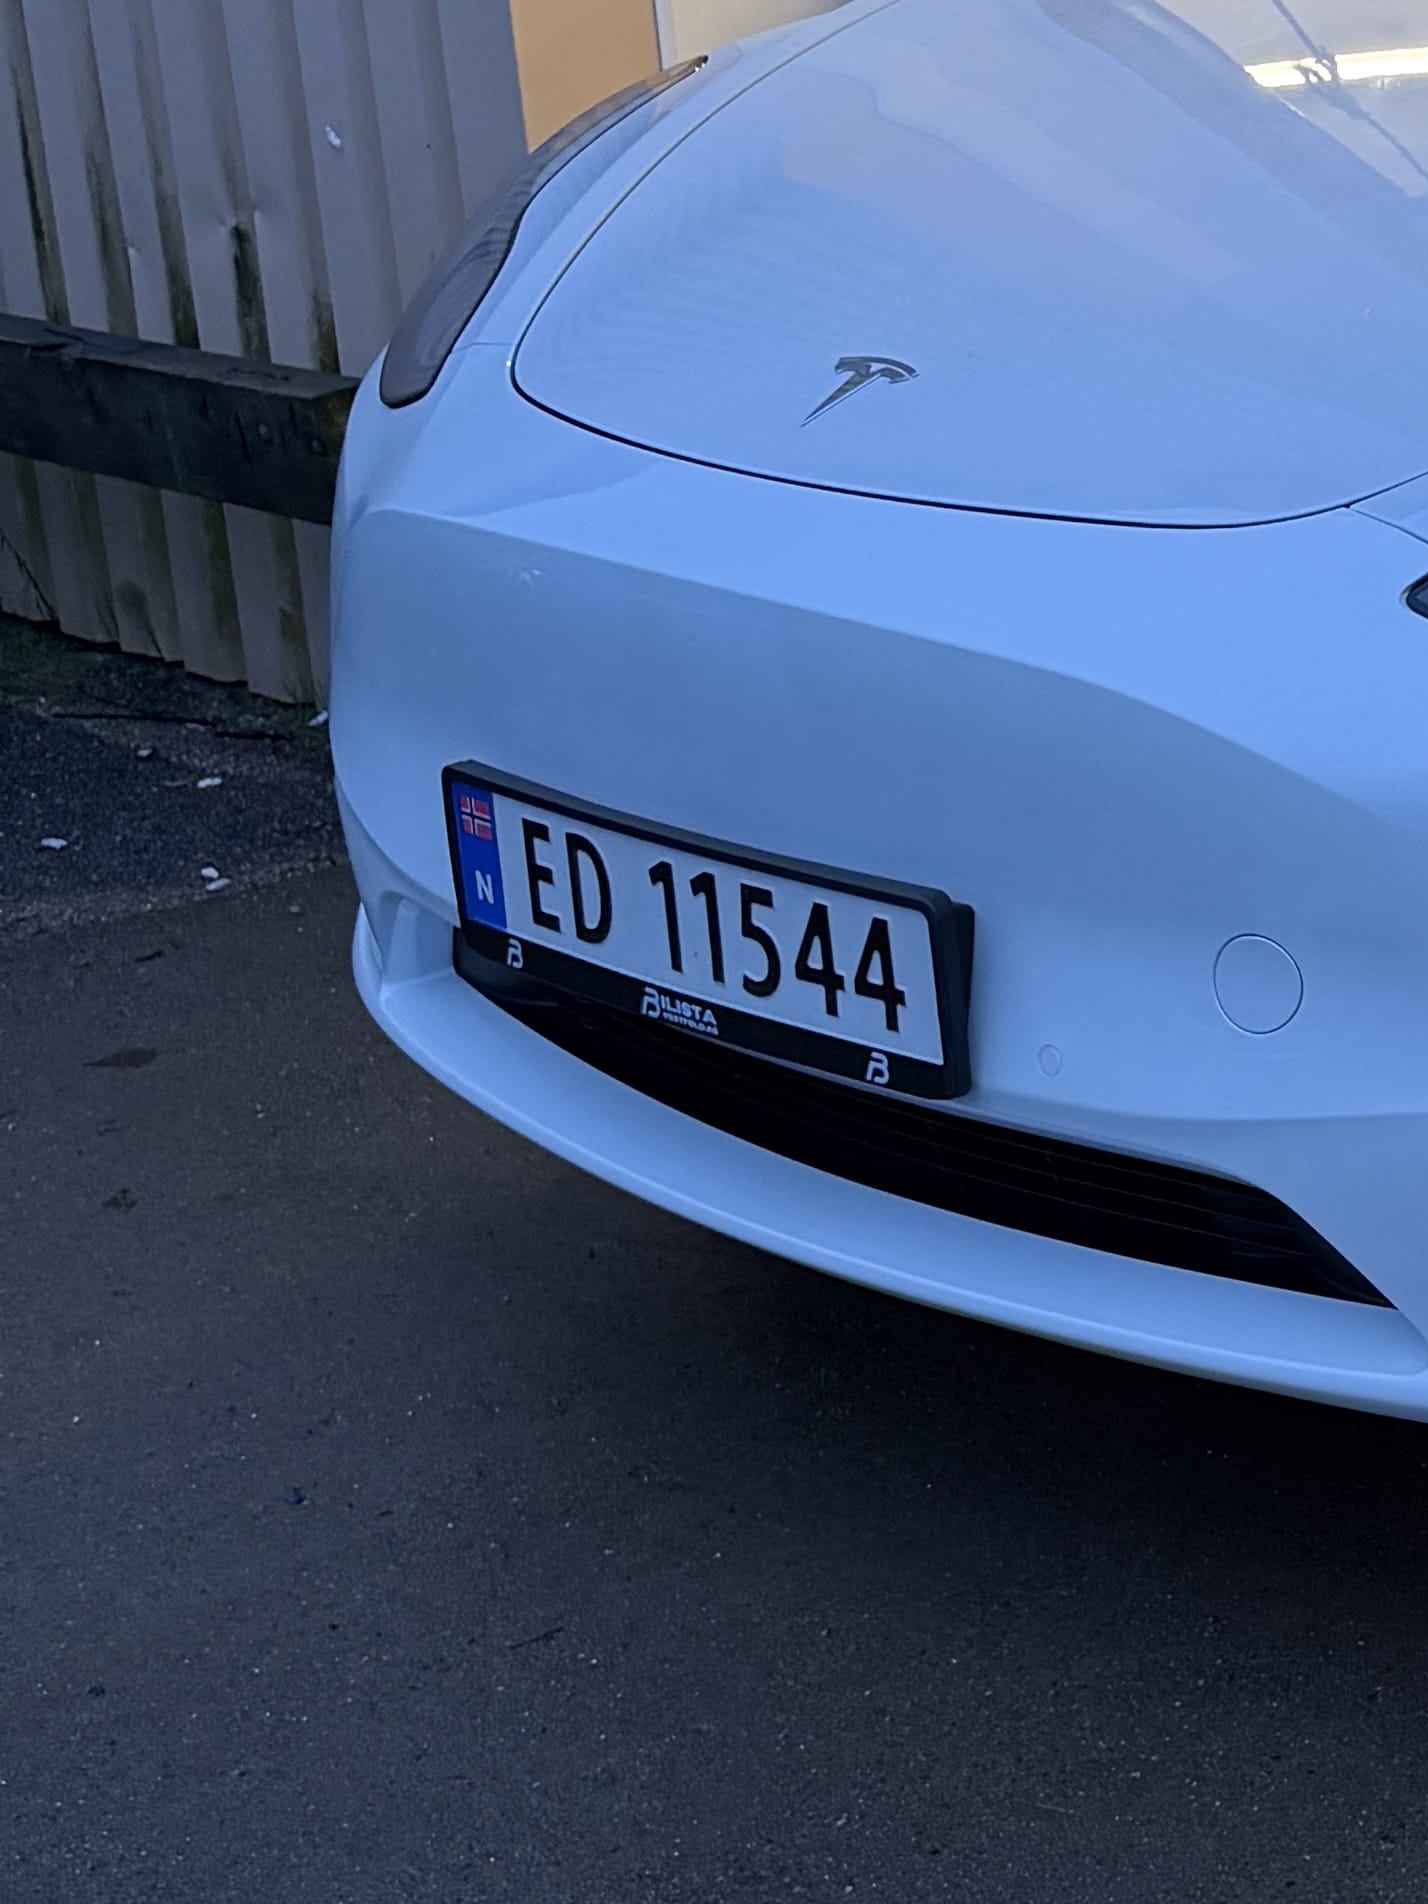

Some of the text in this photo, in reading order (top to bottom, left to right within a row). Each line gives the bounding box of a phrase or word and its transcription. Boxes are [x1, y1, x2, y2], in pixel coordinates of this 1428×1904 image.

[475, 869, 493, 904] N
[521, 817, 906, 1032] ED 11544
